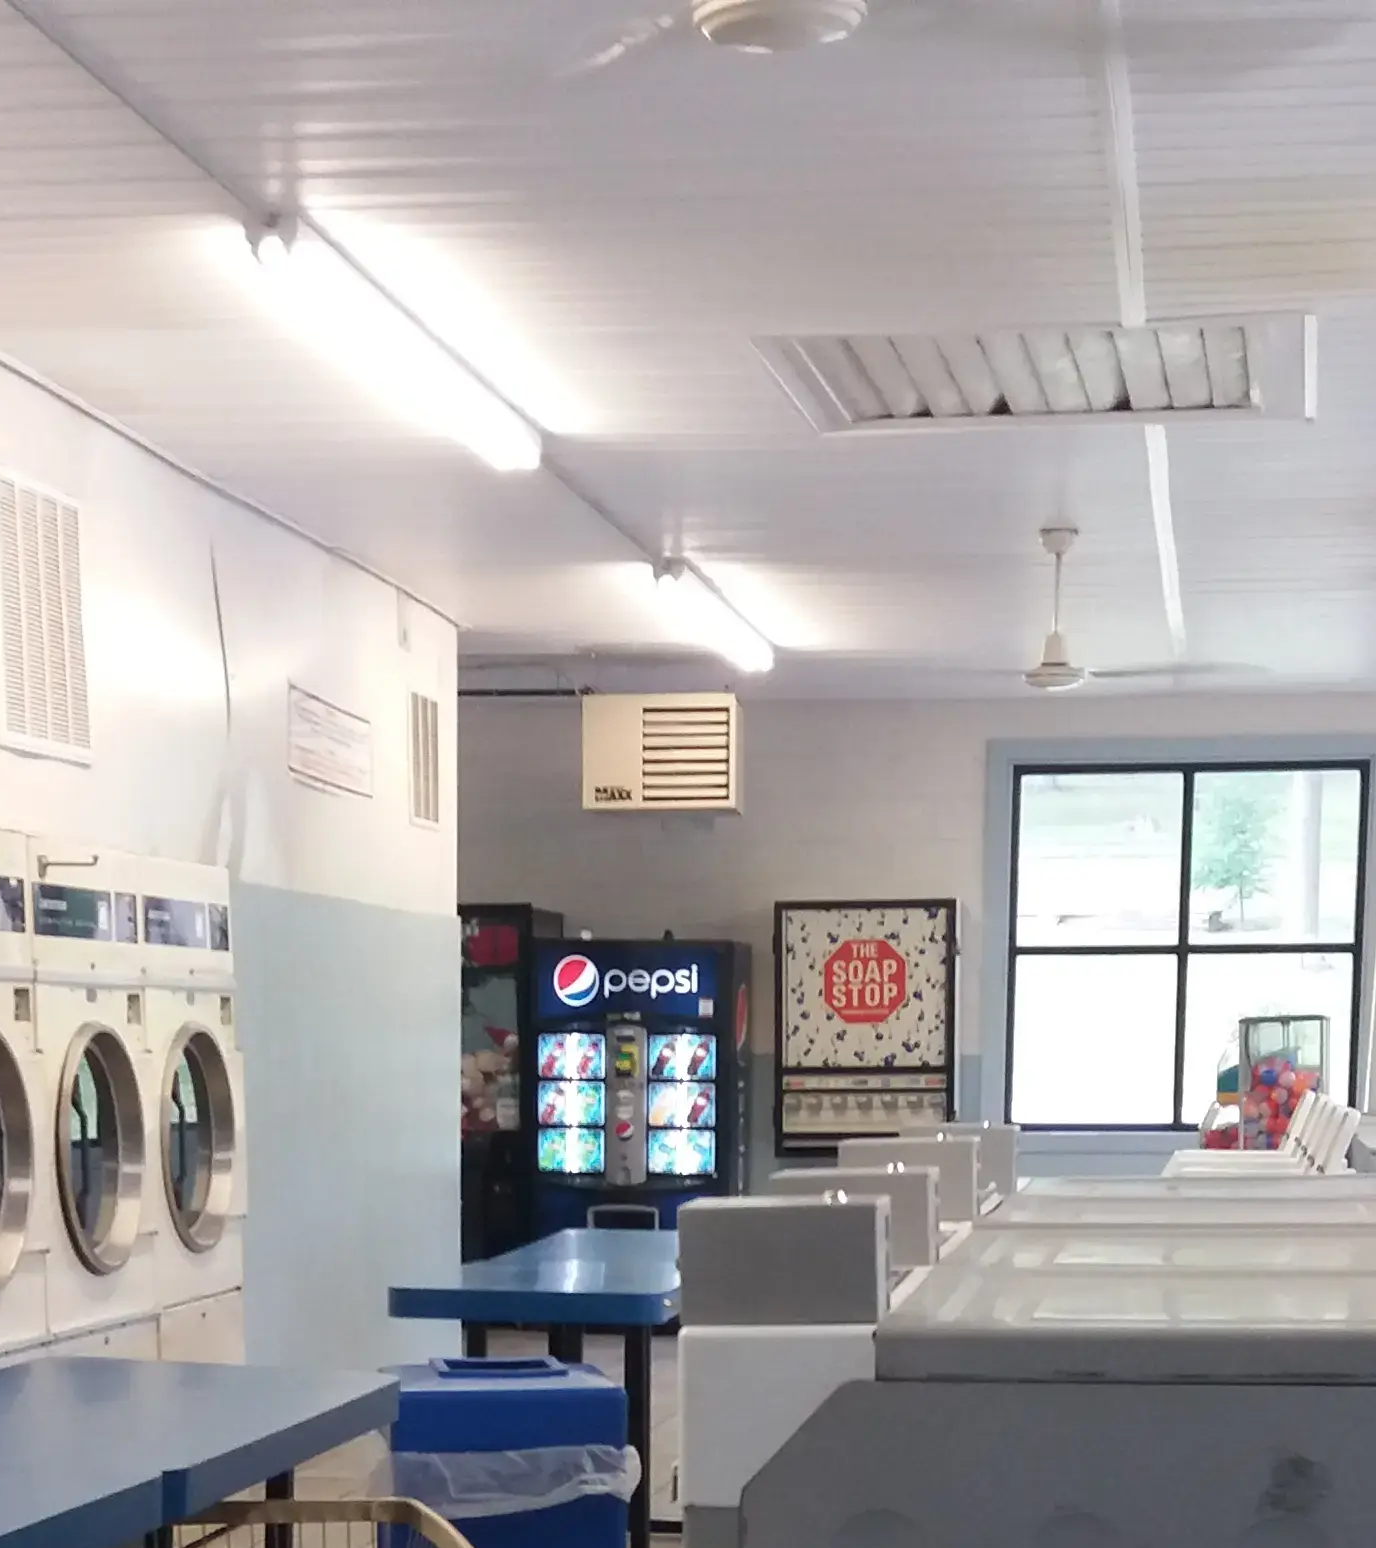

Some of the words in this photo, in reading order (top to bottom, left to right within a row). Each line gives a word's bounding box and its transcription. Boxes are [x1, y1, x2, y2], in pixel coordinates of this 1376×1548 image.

[851, 943, 879, 958] THE
[603, 963, 700, 999] pepsi
[832, 959, 898, 984] SOAP
[832, 984, 898, 1008] STOP
